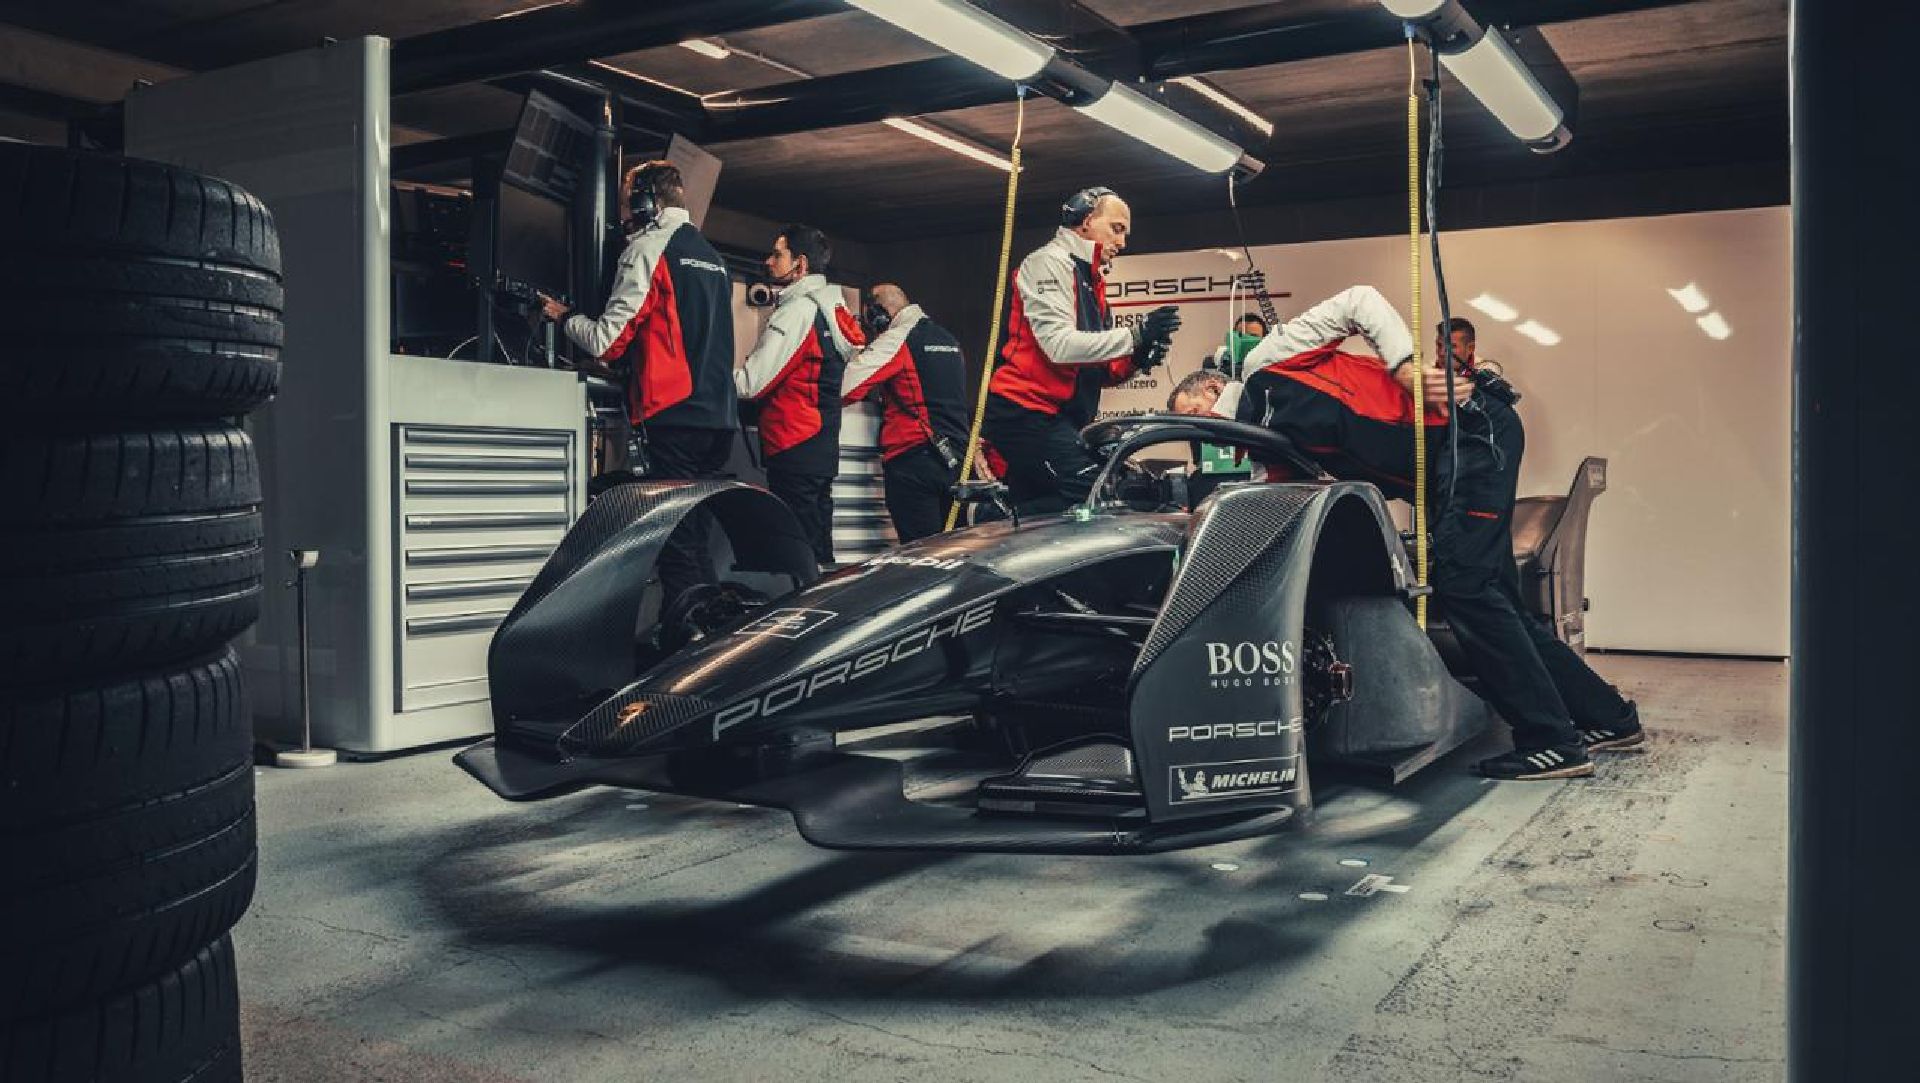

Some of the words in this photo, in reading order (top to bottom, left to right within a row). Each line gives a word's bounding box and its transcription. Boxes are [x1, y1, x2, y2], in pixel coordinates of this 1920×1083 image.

[1105, 273, 1263, 298] ORSCHE
[1205, 640, 1295, 676] BOSS
[712, 600, 997, 742] PORSCHE
[1211, 678, 1252, 688] HUGO
[1168, 716, 1302, 742] PORSCHE
[1211, 768, 1296, 789] MICHELIN
